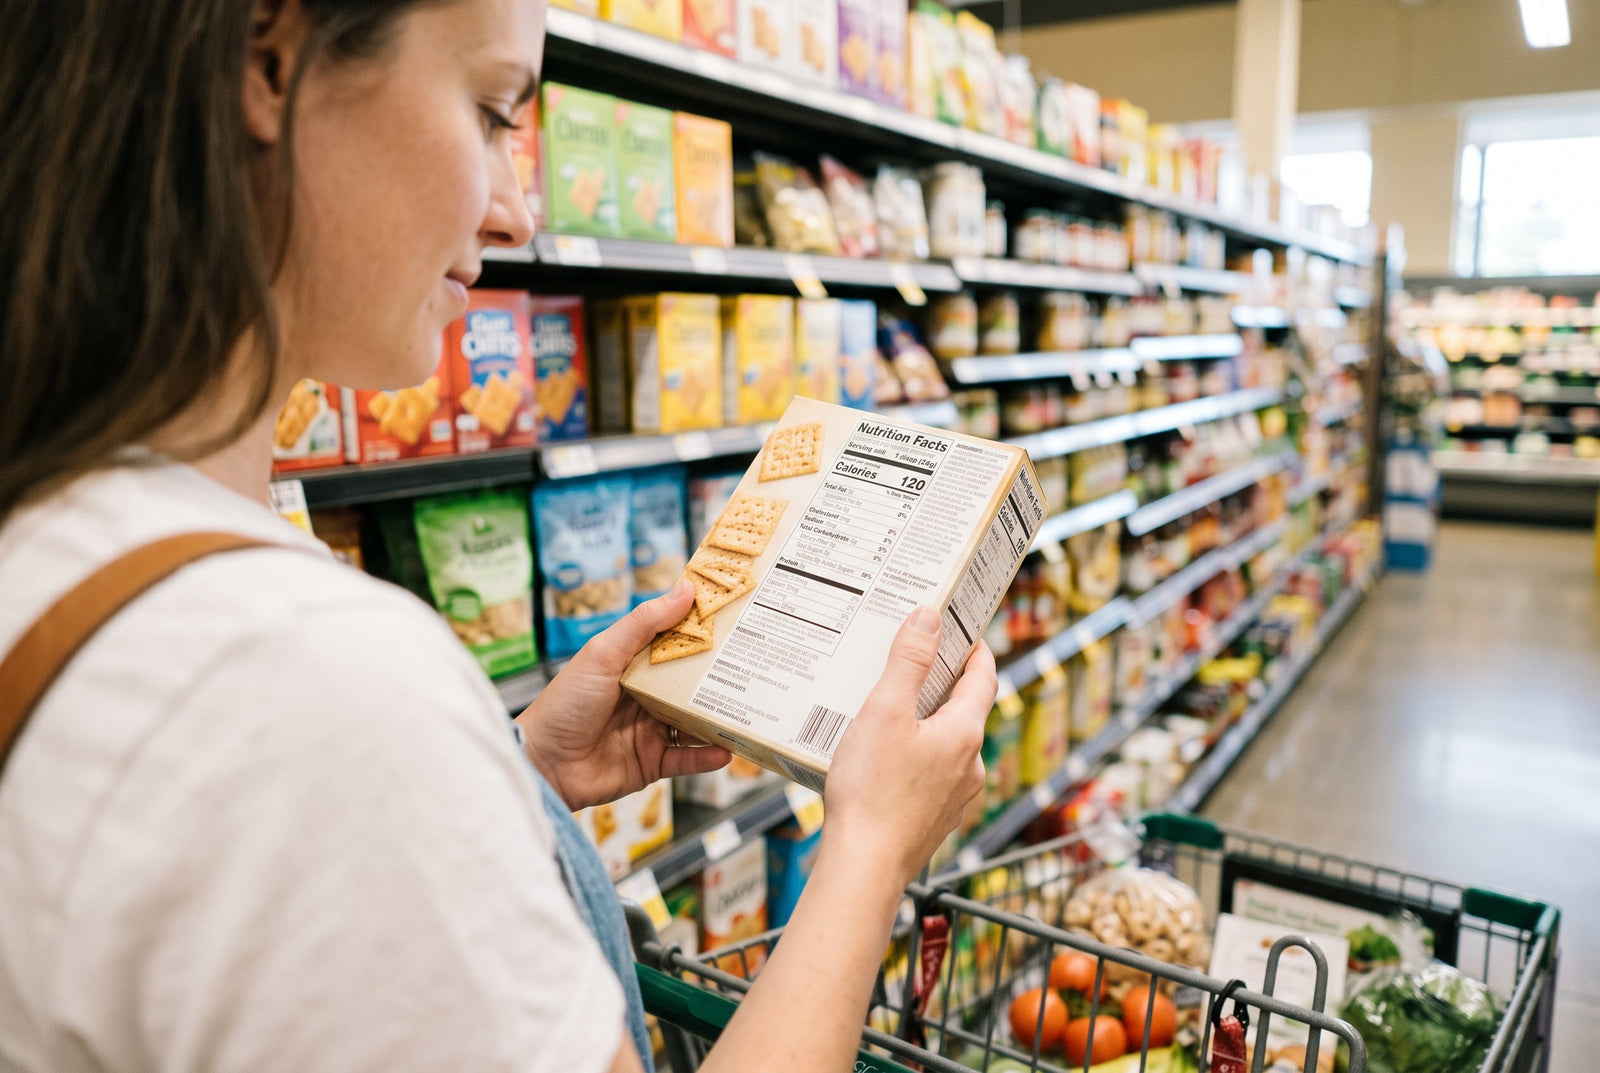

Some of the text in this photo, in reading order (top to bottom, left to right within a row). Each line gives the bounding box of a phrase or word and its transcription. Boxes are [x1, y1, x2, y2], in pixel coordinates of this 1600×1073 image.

[848, 441, 873, 453] Serving
[857, 422, 911, 443] Nutrition
[913, 435, 948, 452] Facts
[835, 461, 926, 491] Calories 120
